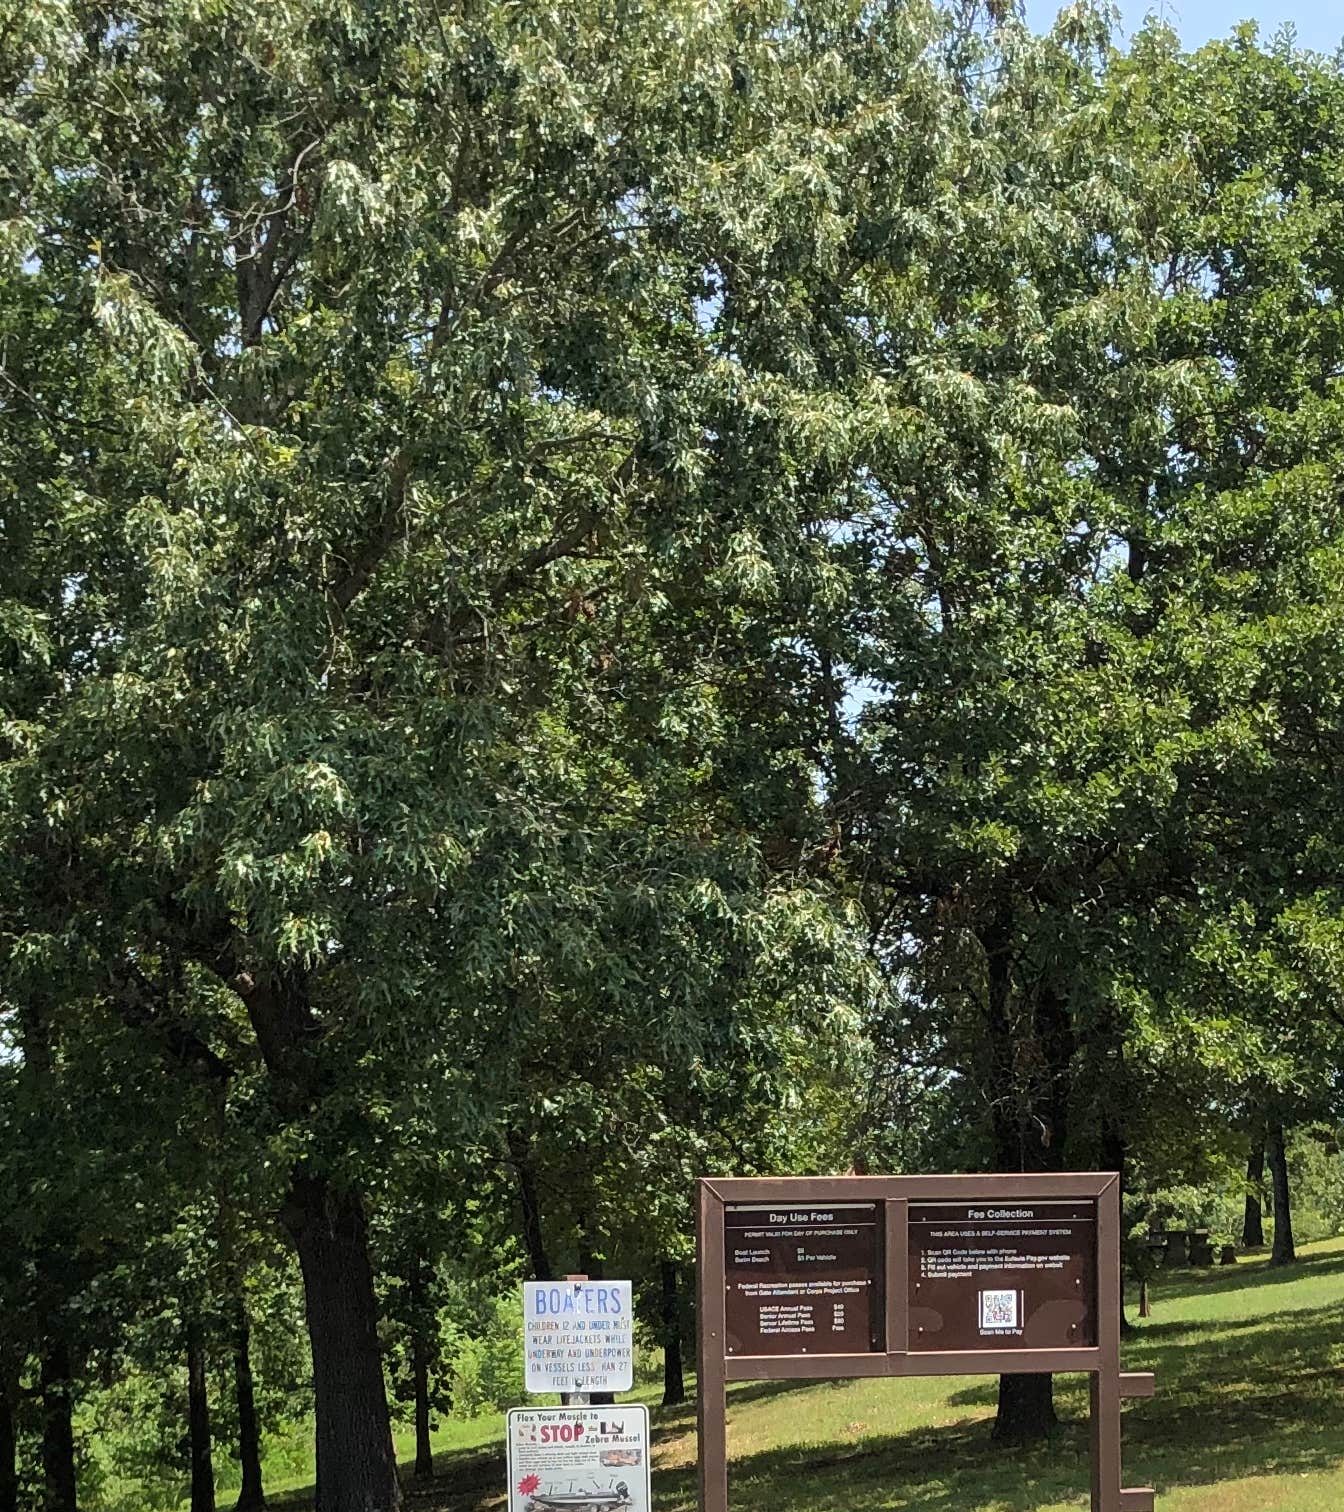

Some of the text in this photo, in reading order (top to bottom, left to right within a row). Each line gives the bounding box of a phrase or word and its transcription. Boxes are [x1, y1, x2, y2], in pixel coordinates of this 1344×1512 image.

[769, 1212, 834, 1223] Day Use Fees
[968, 1209, 1034, 1219] Fee Collection
[979, 1263, 1004, 1271] payment
[535, 1287, 622, 1315] BOAERS
[528, 1321, 559, 1331] CHILDREN
[573, 1320, 586, 1331] AND
[589, 1320, 611, 1330] UNDER
[613, 1319, 630, 1330] MUST
[1012, 1328, 1023, 1336] Pay
[532, 1335, 553, 1345] WEAR
[605, 1334, 626, 1344] WHILE
[528, 1348, 564, 1359] UNDERWAY
[567, 1348, 582, 1358] AND
[531, 1362, 541, 1373] ON
[545, 1362, 575, 1373] VESSELS
[578, 1362, 596, 1372] LESS
[619, 1361, 628, 1371] 27
[552, 1376, 570, 1386] FEET
[582, 1375, 608, 1386] LENGTH
[517, 1411, 599, 1422] Flex Your Muscle to
[540, 1424, 585, 1443] STOP
[585, 1433, 641, 1444] Zebra Mussel
